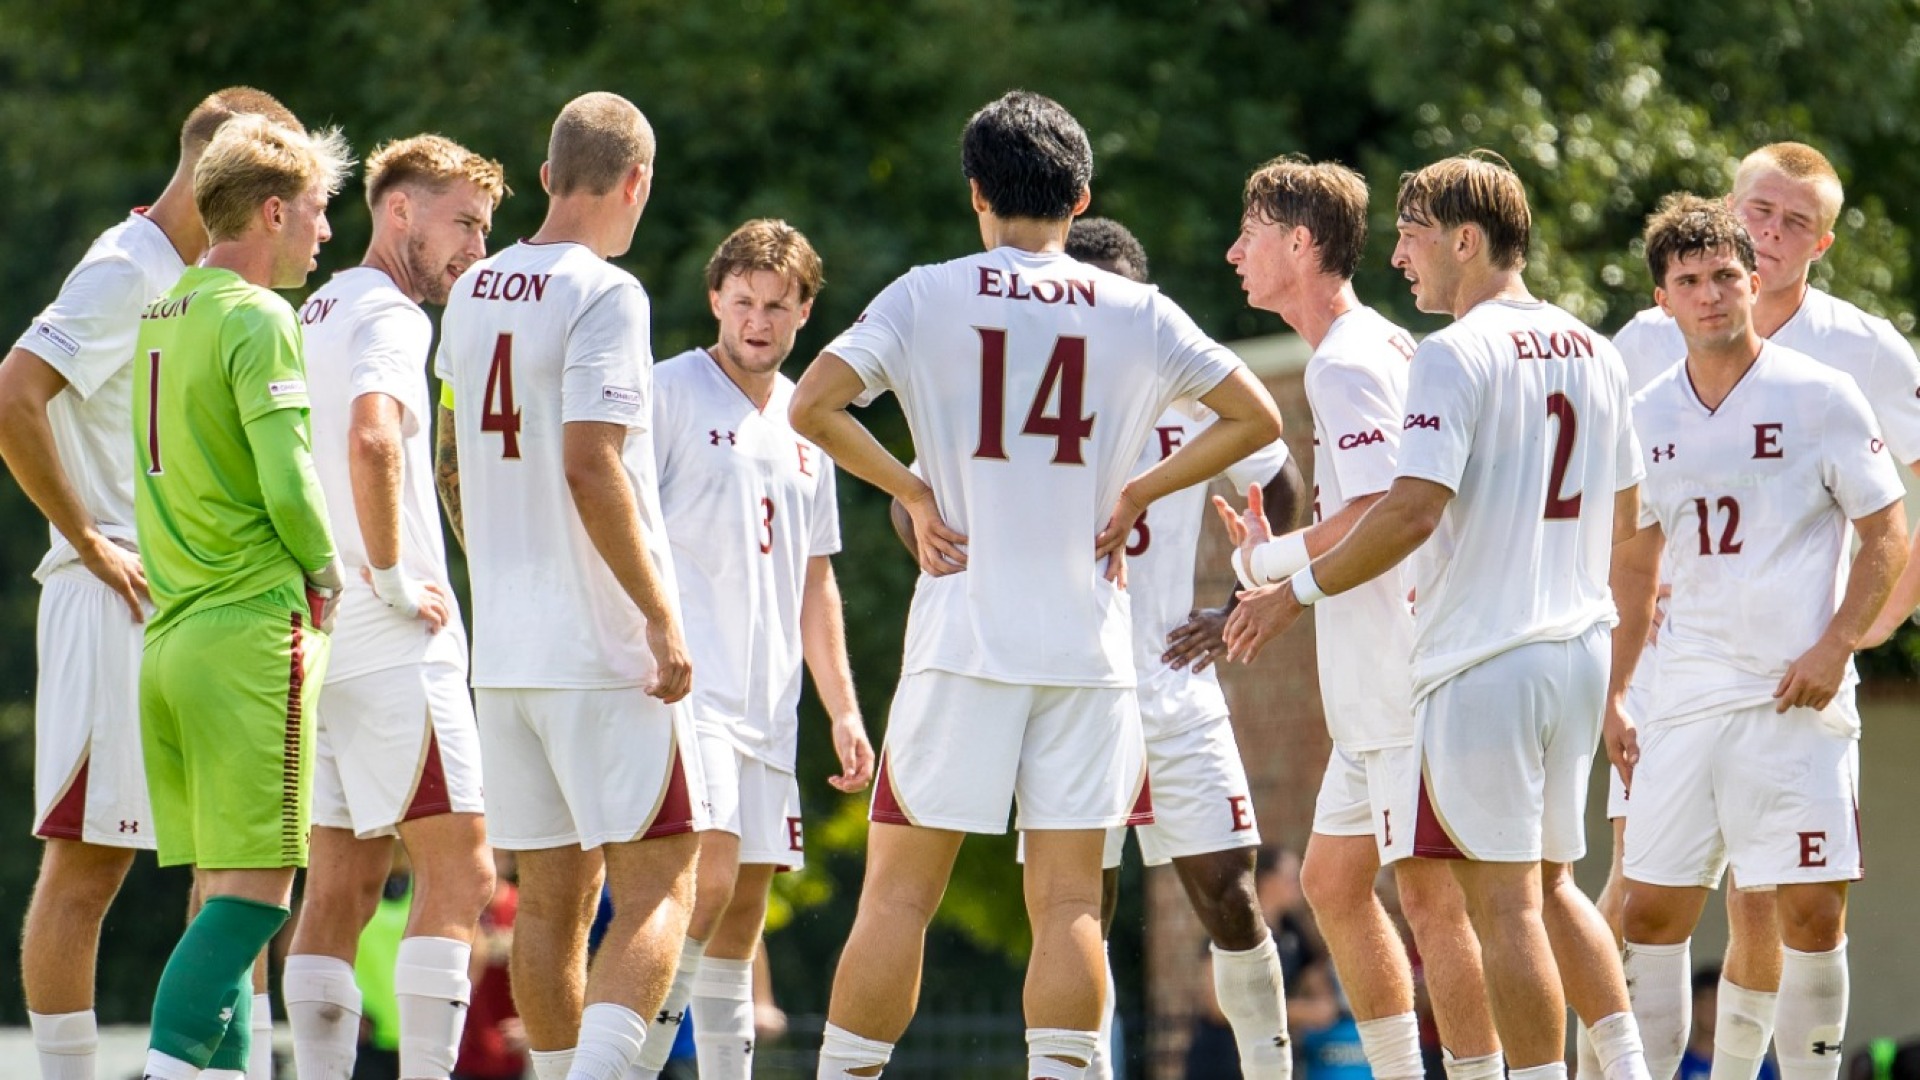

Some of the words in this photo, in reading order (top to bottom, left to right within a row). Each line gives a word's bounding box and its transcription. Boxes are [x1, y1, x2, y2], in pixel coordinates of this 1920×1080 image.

[471, 269, 552, 302] ELON
[977, 266, 1096, 307] ELON
[300, 298, 338, 325] ON
[1508, 329, 1594, 360] ELON
[147, 349, 163, 476] 1
[480, 330, 523, 461] 4
[970, 325, 1097, 467] 14
[1338, 428, 1385, 450] CAA
[1403, 413, 1440, 431] CAA
[796, 441, 813, 478] E
[1543, 390, 1584, 522] 2
[1751, 423, 1784, 459] E
[760, 496, 775, 554] 3
[1693, 495, 1744, 556] 12
[1226, 795, 1252, 832] E
[786, 816, 804, 851] E
[1796, 831, 1827, 868] E
